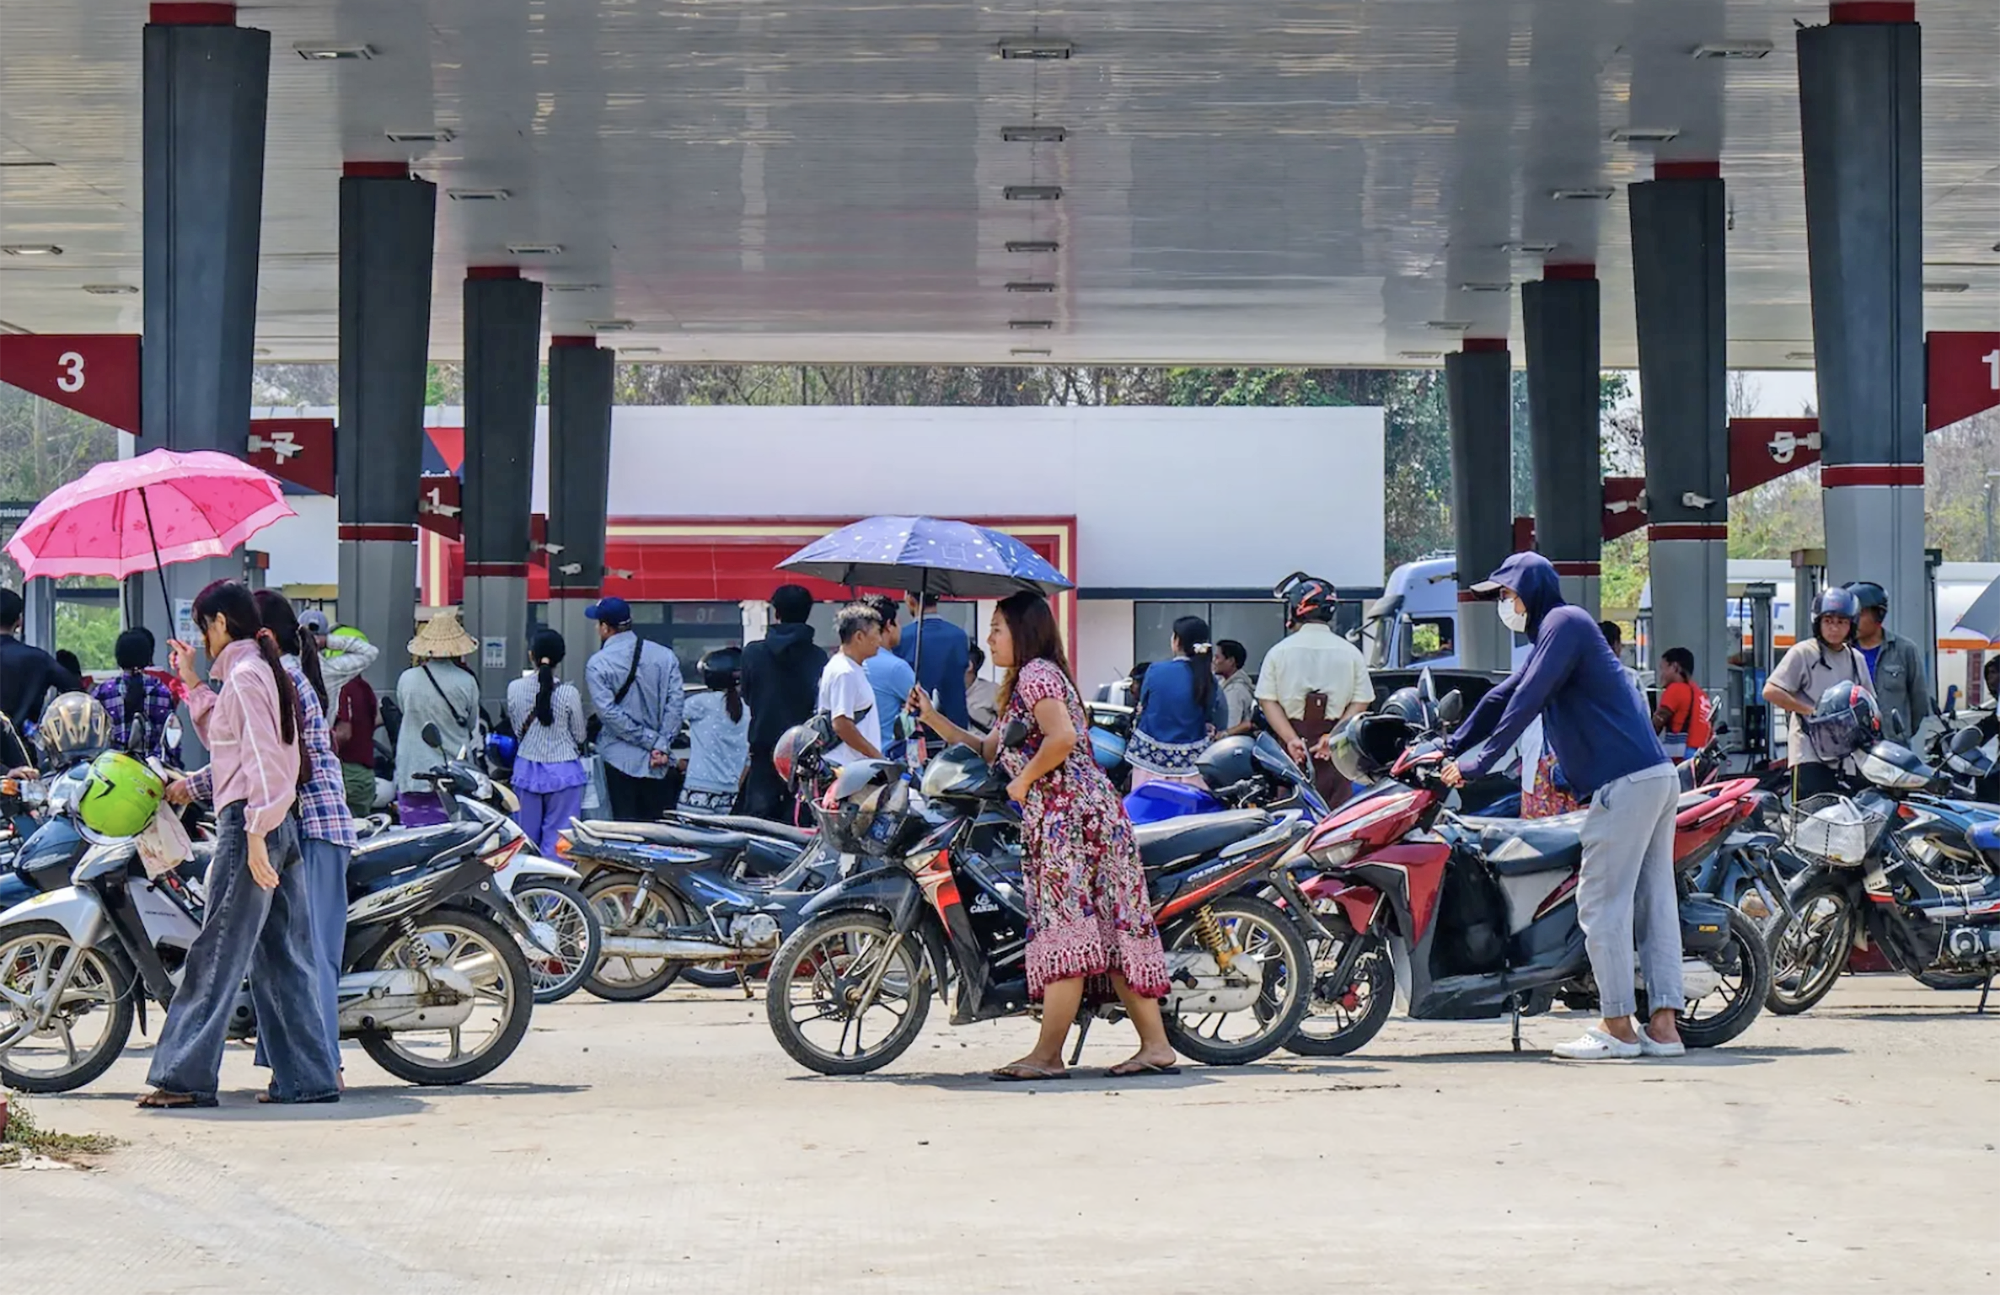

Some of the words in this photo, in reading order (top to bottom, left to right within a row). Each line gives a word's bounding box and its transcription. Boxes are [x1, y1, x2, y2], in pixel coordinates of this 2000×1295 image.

[57, 351, 85, 392] 3
[1981, 349, 2000, 390] 1
[271, 432, 295, 465] 7
[969, 903, 1000, 914] CANDA
